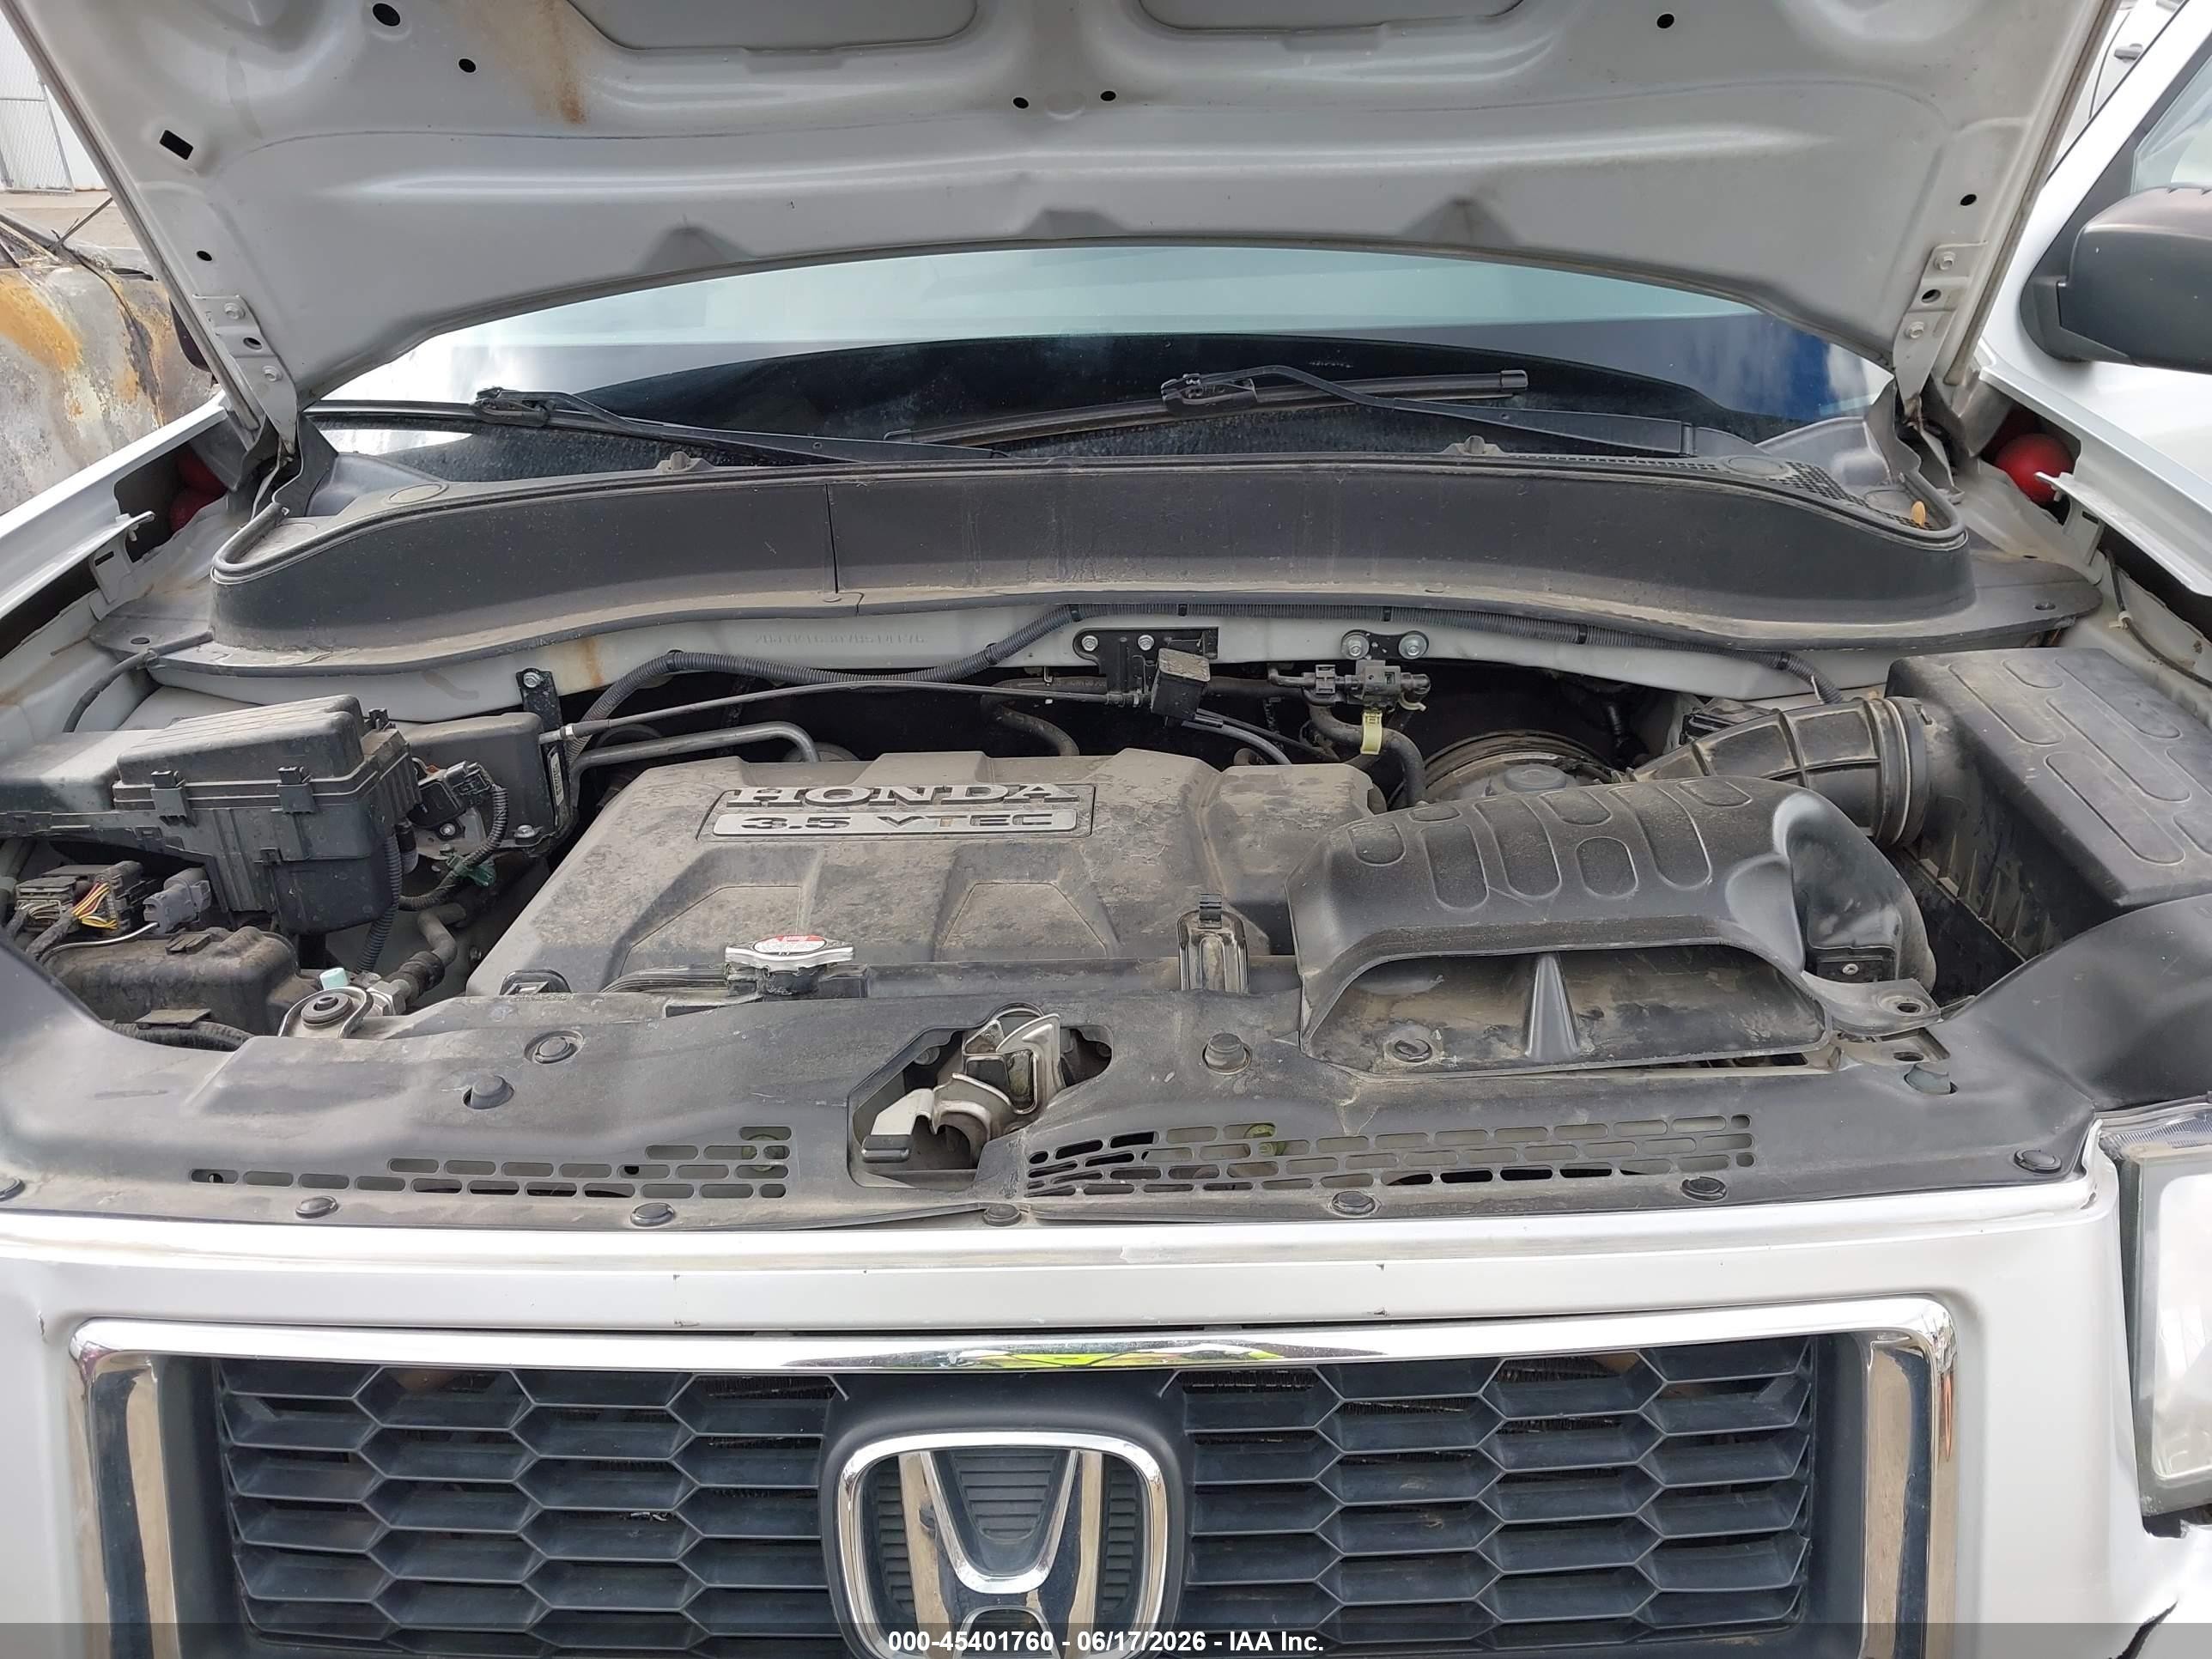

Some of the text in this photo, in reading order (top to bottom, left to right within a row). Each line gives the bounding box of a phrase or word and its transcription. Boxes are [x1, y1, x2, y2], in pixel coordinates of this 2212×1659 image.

[726, 784, 1080, 807] HONDA
[740, 814, 1053, 830] 3.5 VTEC
